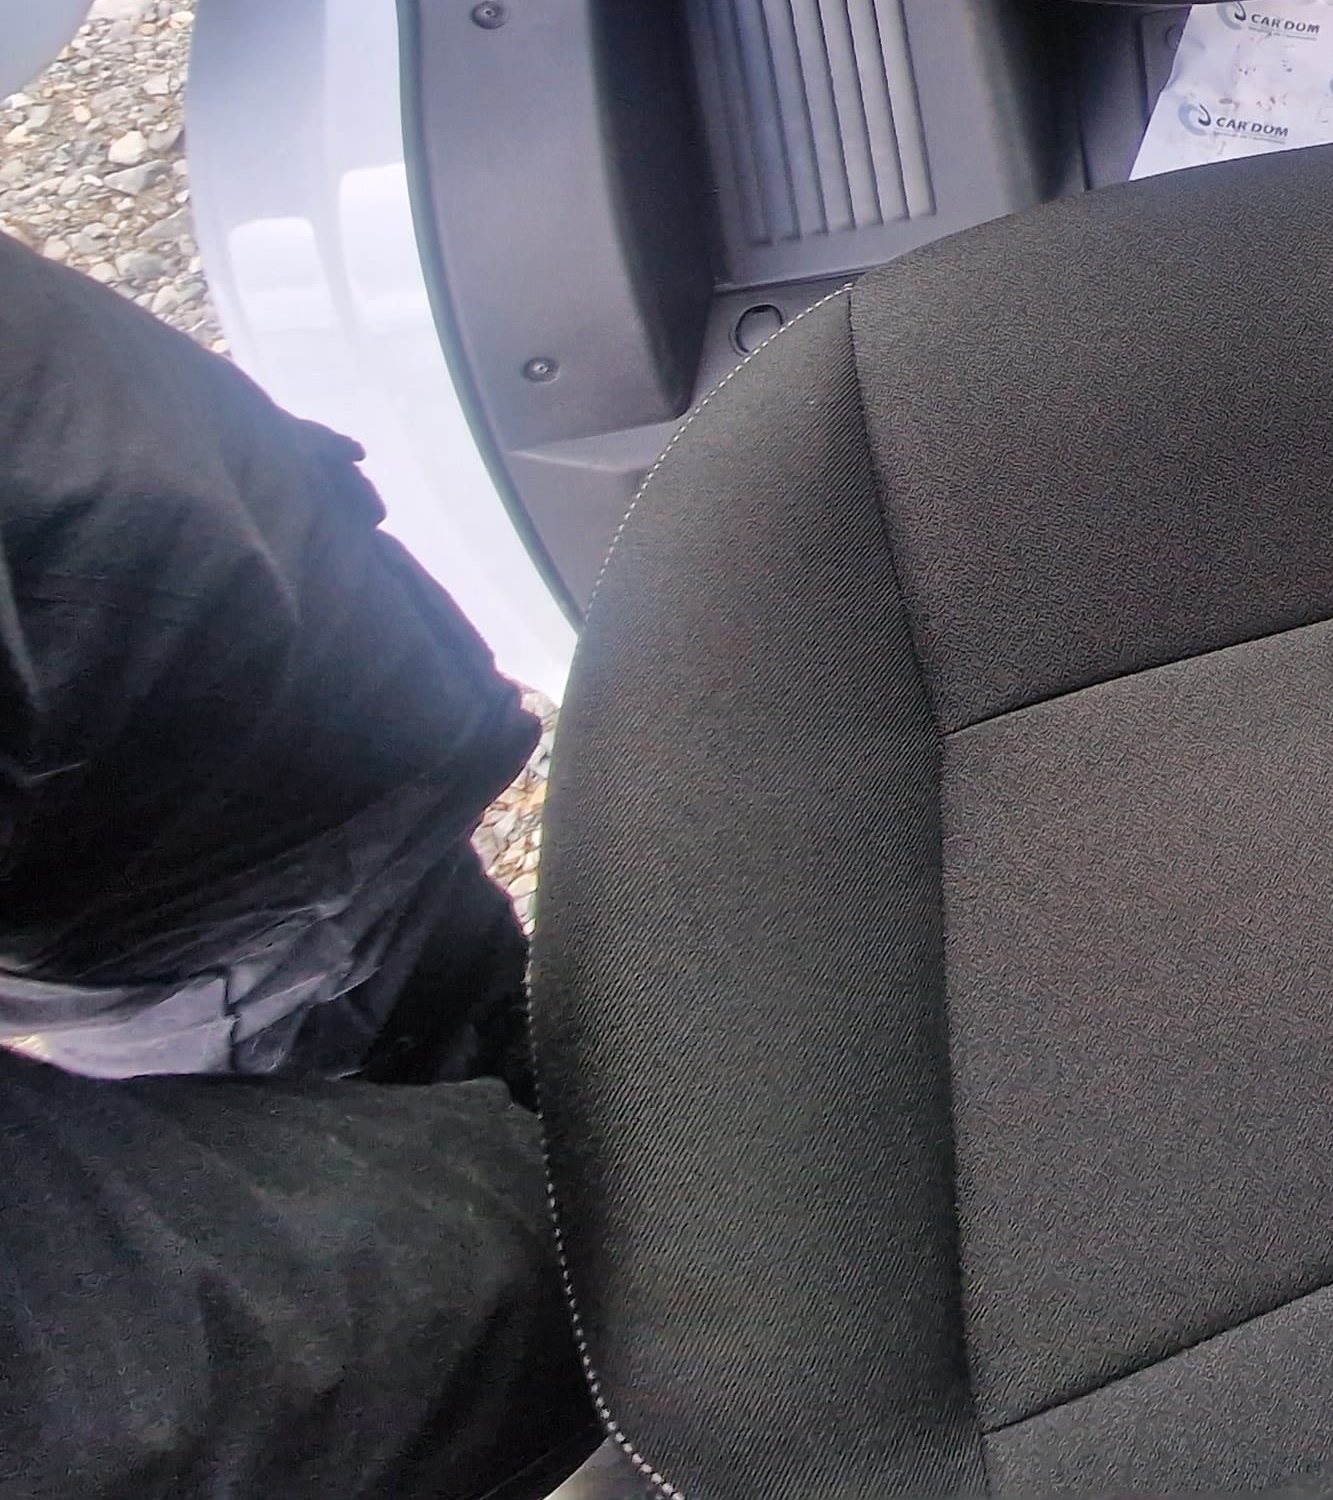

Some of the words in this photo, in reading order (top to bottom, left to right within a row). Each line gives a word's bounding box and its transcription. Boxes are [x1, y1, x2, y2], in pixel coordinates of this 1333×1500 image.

[1250, 13, 1281, 29] CAR
[1284, 20, 1320, 34] DOM
[1216, 116, 1247, 132] CAR
[1250, 123, 1289, 138] DOM
